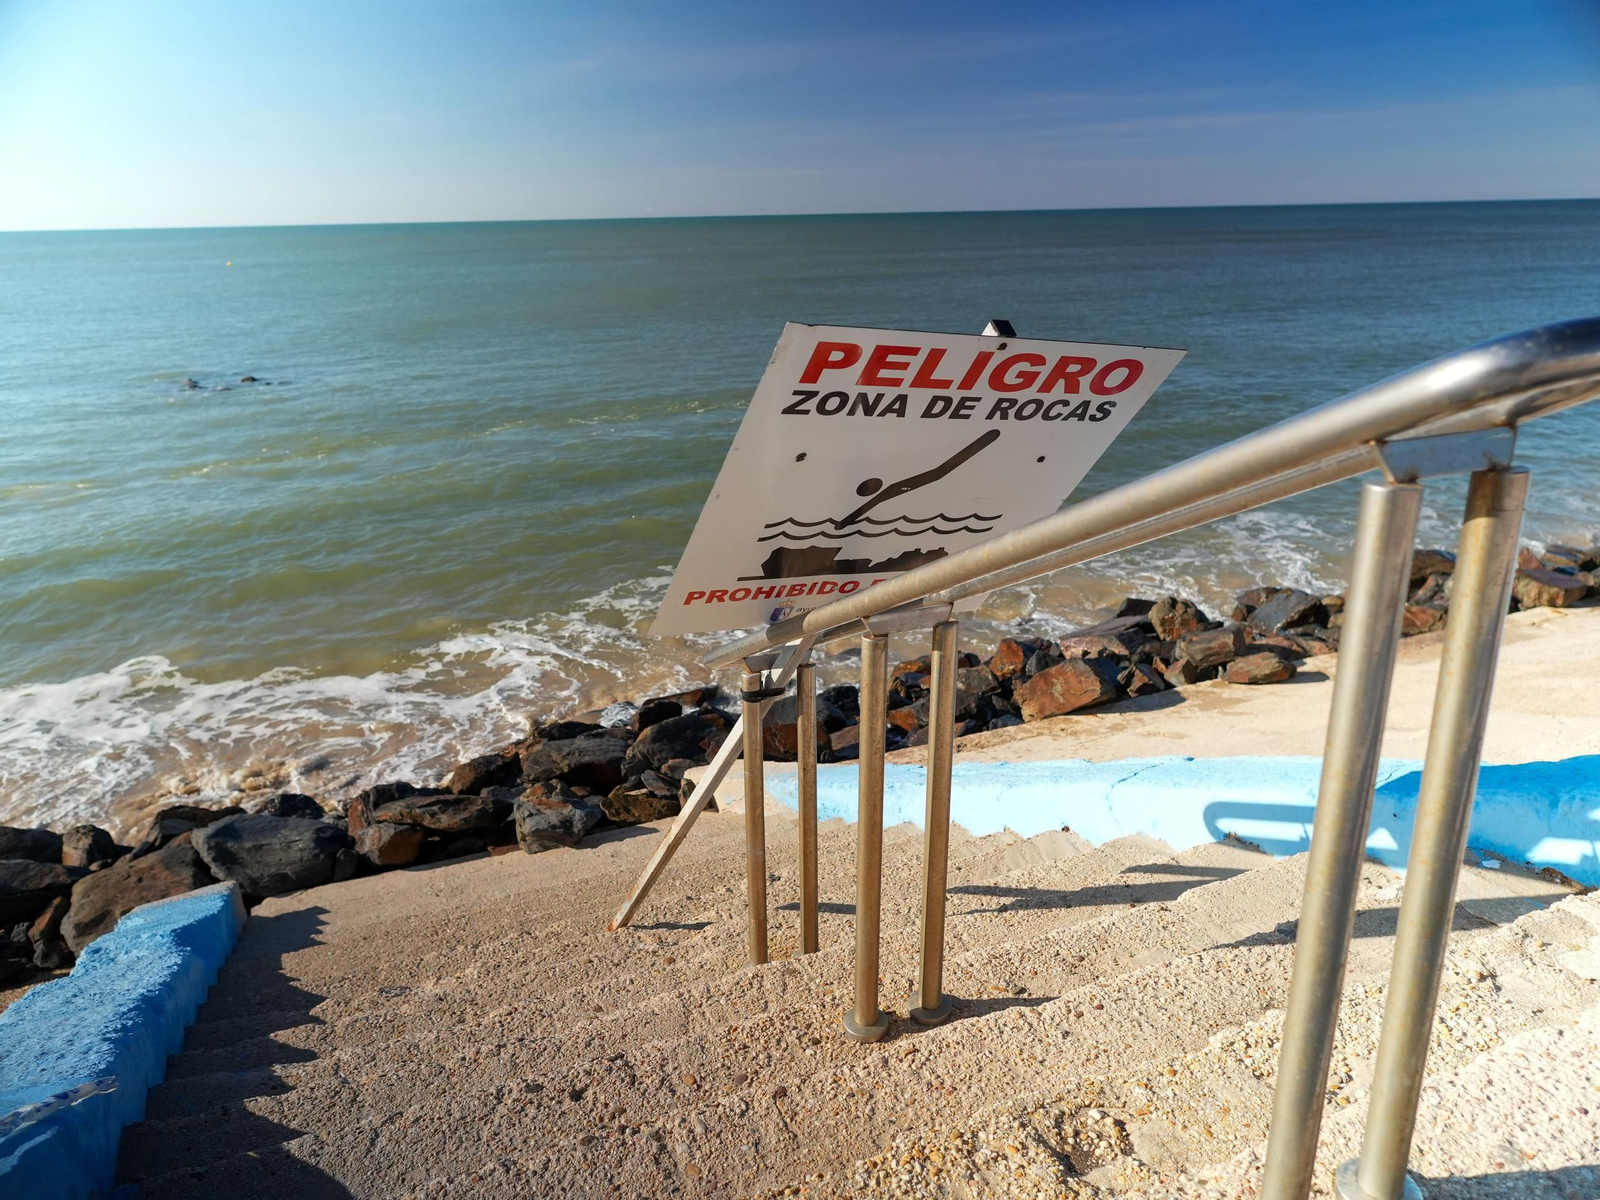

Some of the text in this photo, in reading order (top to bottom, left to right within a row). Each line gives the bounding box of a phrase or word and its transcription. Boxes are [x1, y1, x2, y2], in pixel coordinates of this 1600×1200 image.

[799, 341, 1144, 395] PELIGRO
[781, 390, 1117, 422] ZONA DE ROCAS
[683, 580, 860, 605] PROHIBIDO
